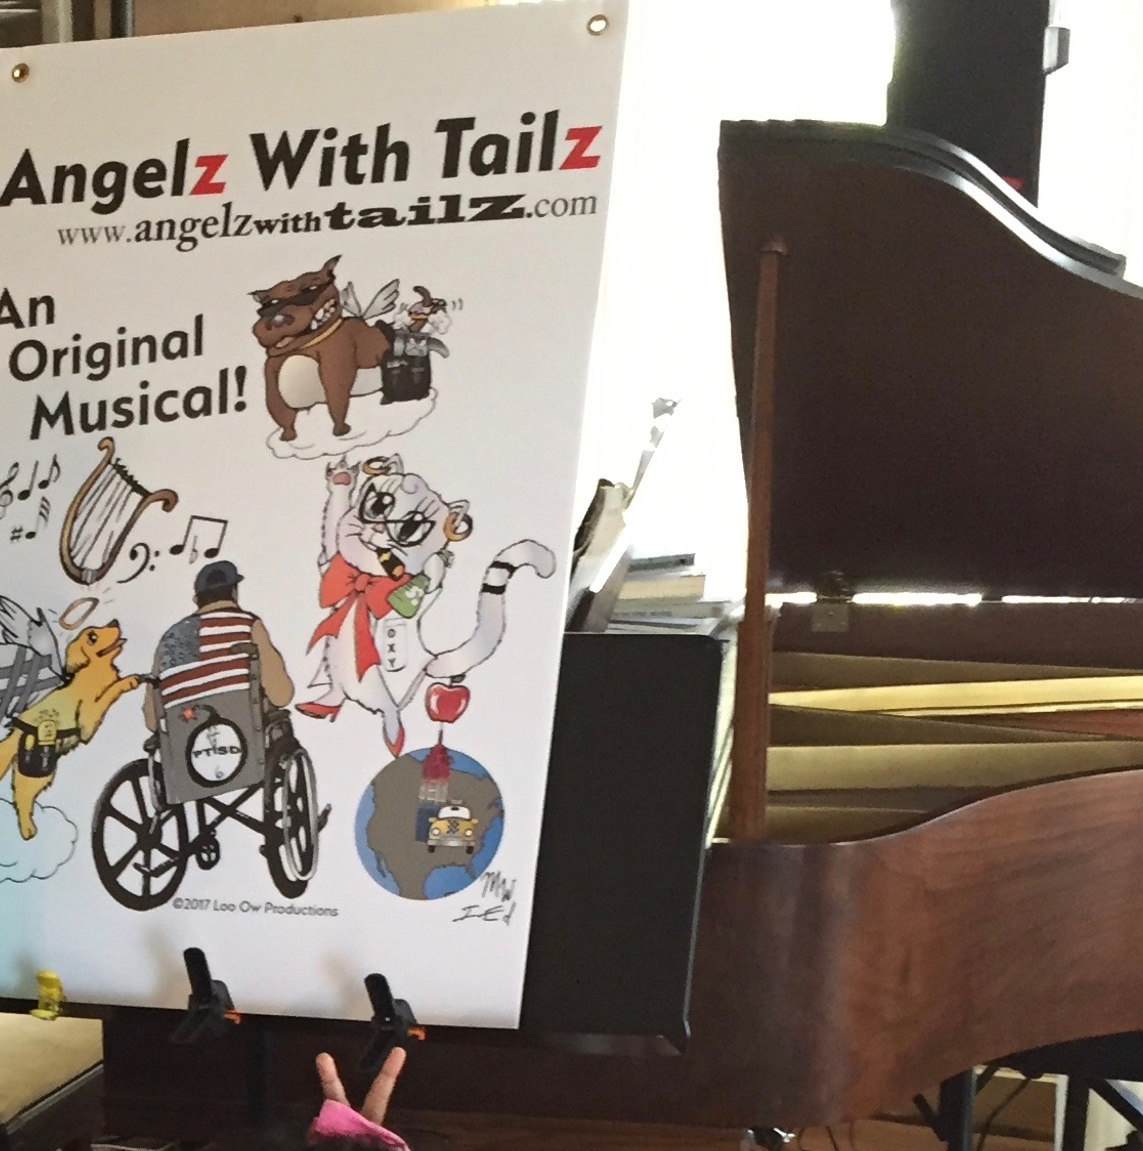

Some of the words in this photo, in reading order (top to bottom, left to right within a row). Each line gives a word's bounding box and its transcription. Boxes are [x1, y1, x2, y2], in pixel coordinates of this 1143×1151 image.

[250, 124, 410, 192] With
[435, 109, 603, 180] Tailz
[57, 193, 598, 253] www.angelzwithtailz.com
[9, 314, 204, 384] Original
[29, 365, 248, 440] Musical!
[264, 902, 339, 917] Productions
